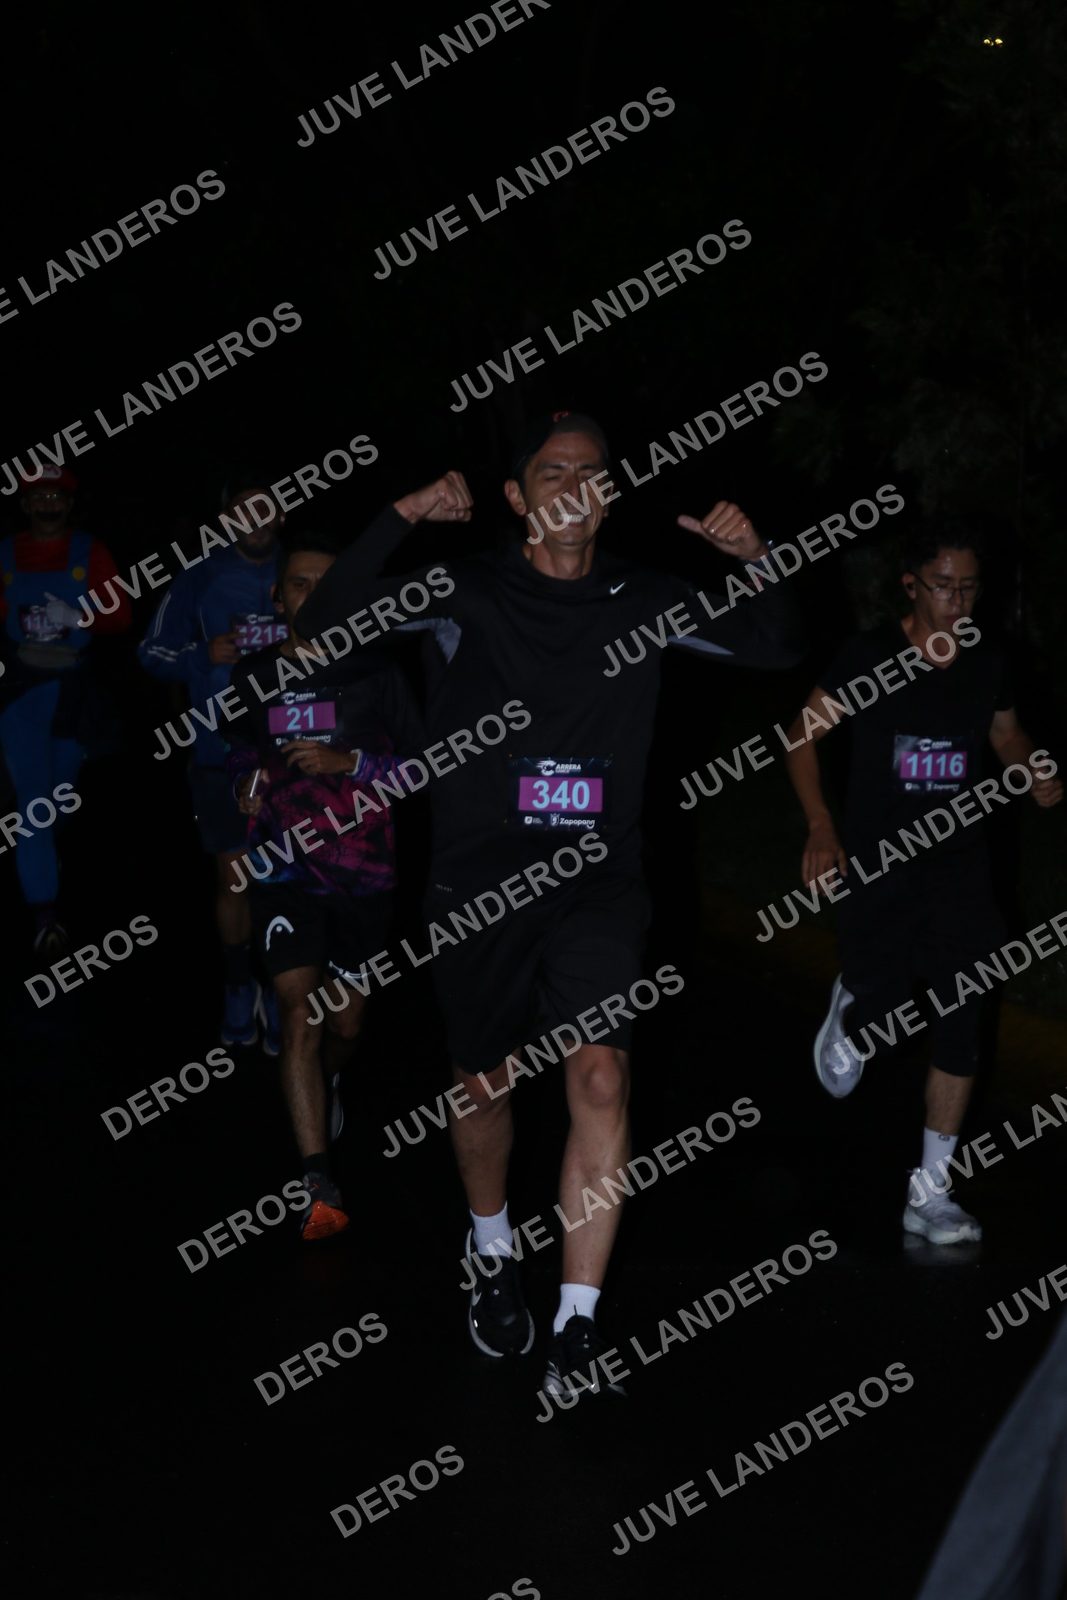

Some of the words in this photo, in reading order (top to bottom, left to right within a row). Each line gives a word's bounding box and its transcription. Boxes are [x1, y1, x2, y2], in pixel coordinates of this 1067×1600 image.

[239, 625, 288, 645] 1215
[286, 705, 315, 731] 21
[906, 753, 964, 777] 1116
[532, 779, 590, 810] 340
